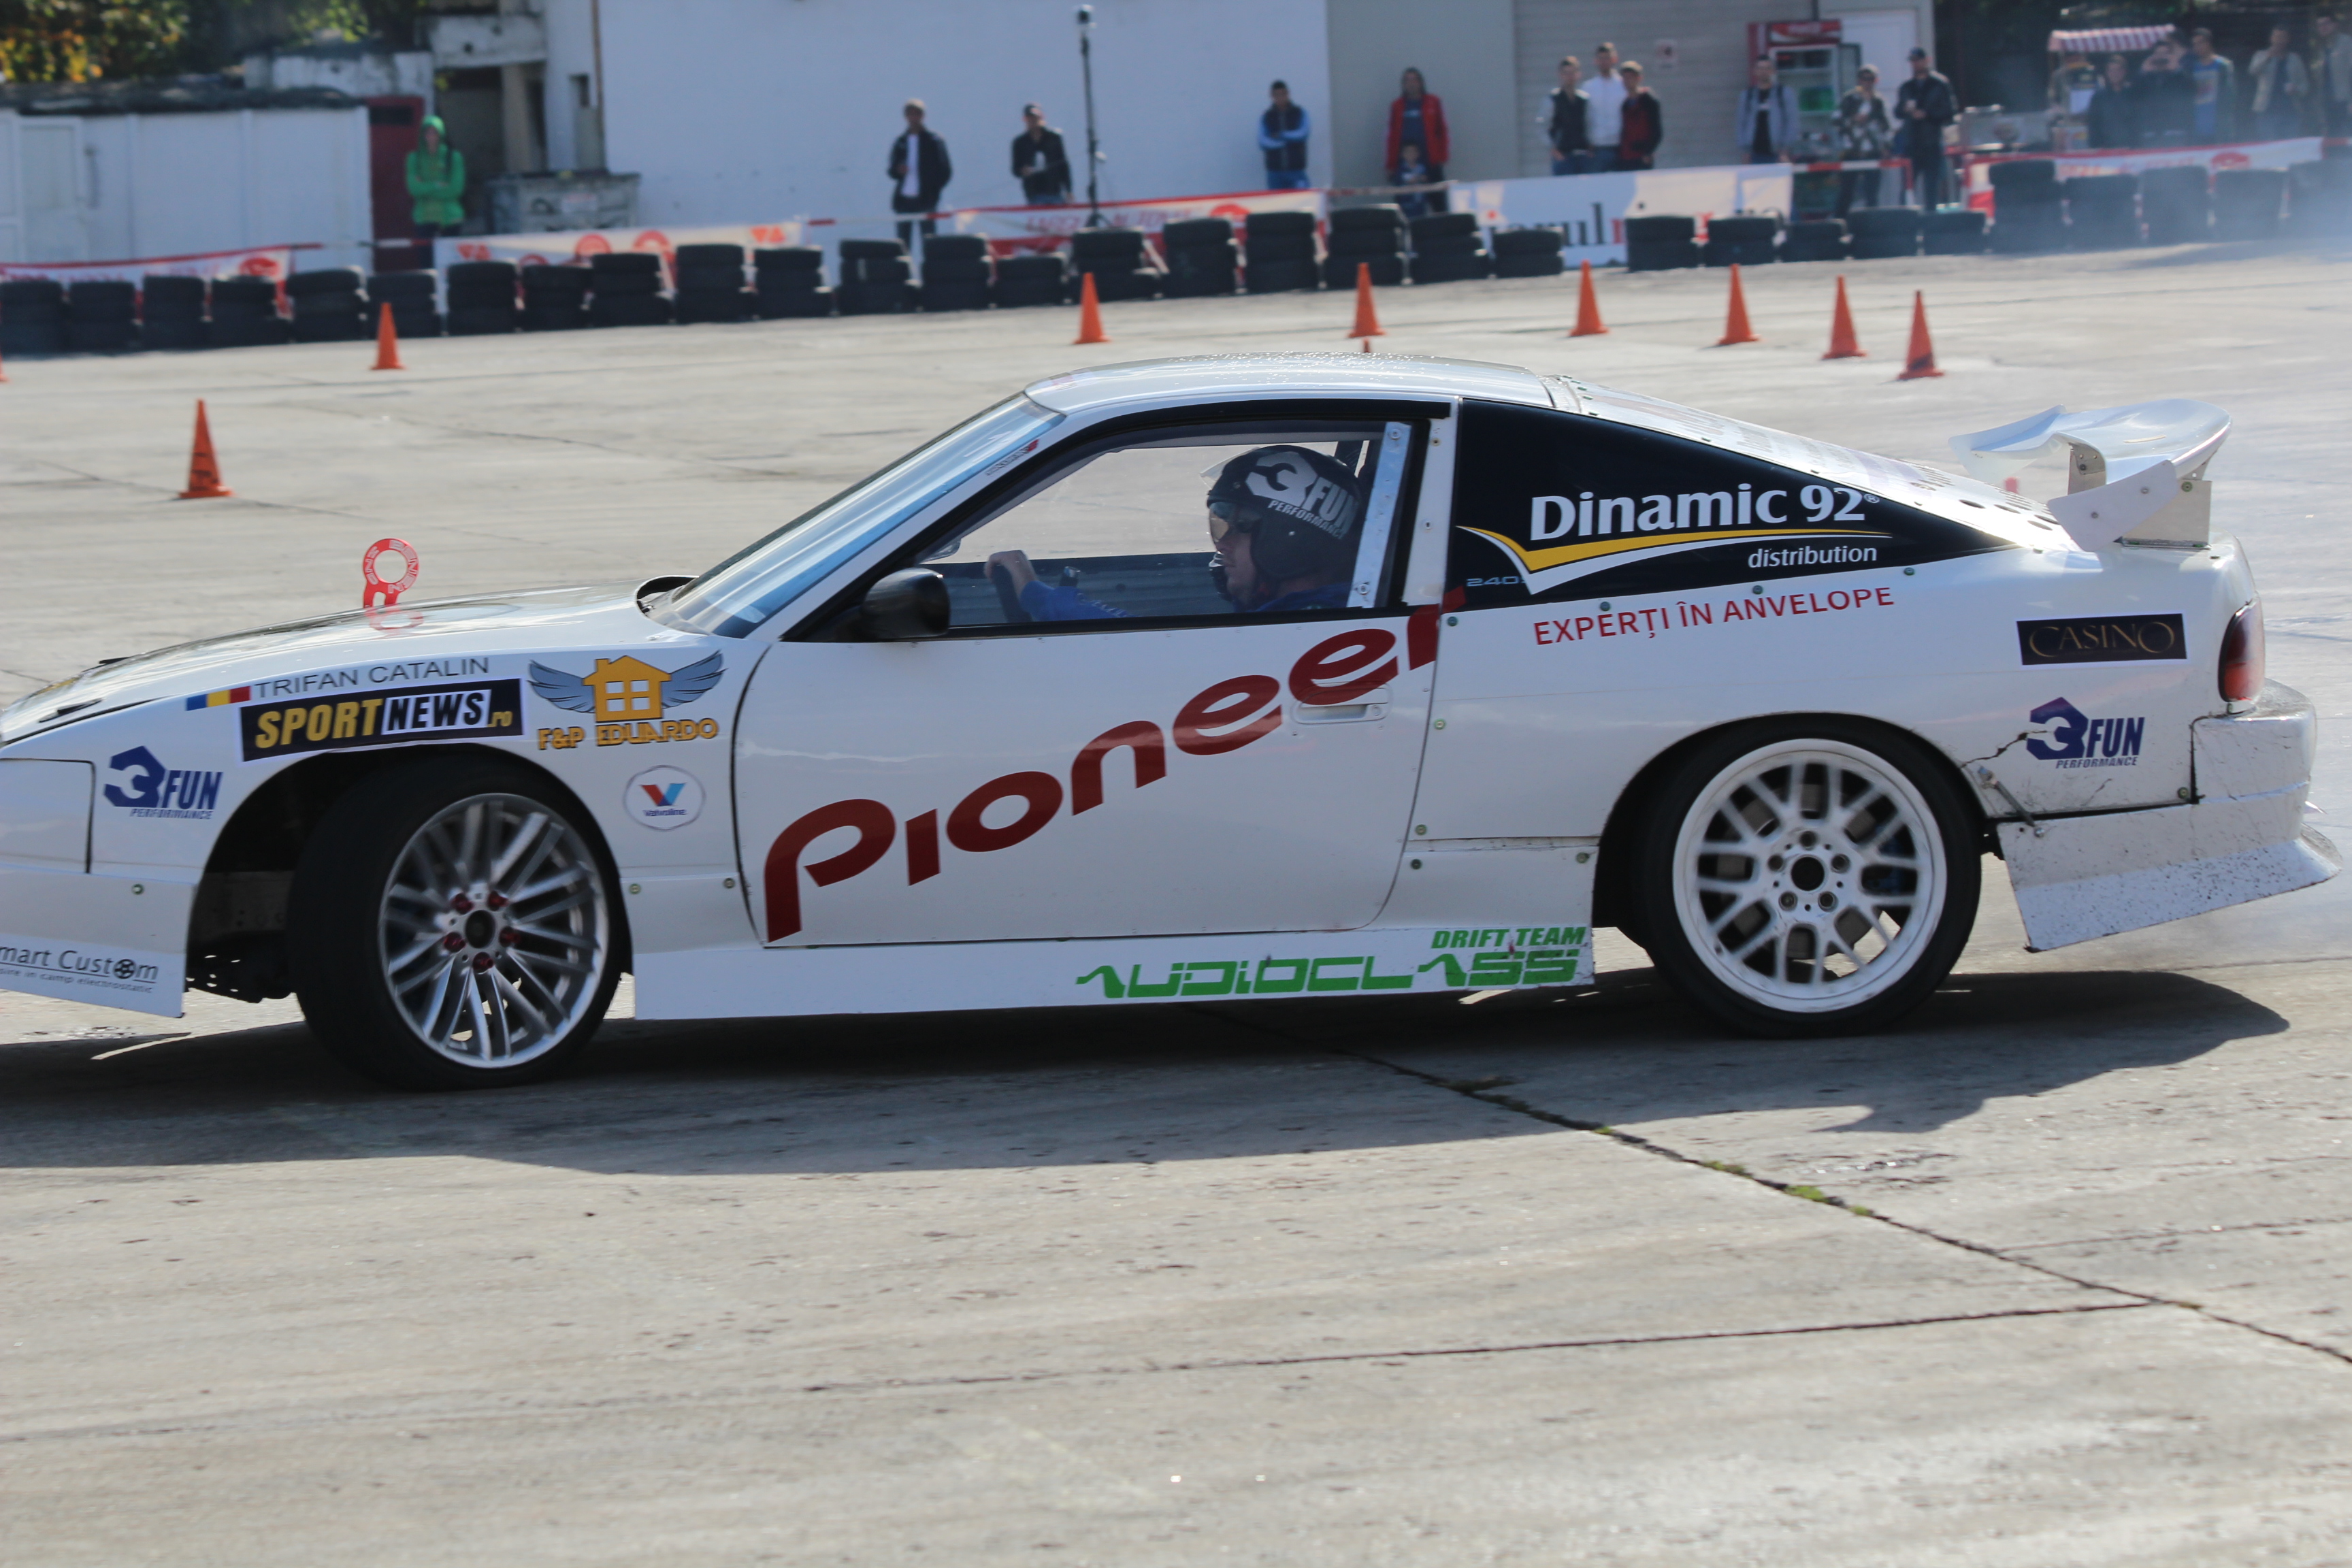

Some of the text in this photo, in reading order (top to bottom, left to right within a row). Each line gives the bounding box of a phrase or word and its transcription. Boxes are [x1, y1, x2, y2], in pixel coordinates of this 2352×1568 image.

[1530, 483, 1787, 540] Dinamic
[1748, 545, 1878, 568] distribution
[1466, 575, 1526, 587] 240
[1675, 600, 1714, 627] ÎN
[1722, 587, 1895, 622] ANVELOPE
[2029, 621, 2175, 657] CASINO
[255, 657, 489, 698] TRIFAN CATALIN
[537, 717, 720, 751] F&P EDUARDO
[764, 585, 1467, 943] Pioneer
[2055, 756, 2138, 769] PERFORMANCE
[1431, 926, 1587, 949] DRIFT TEAM
